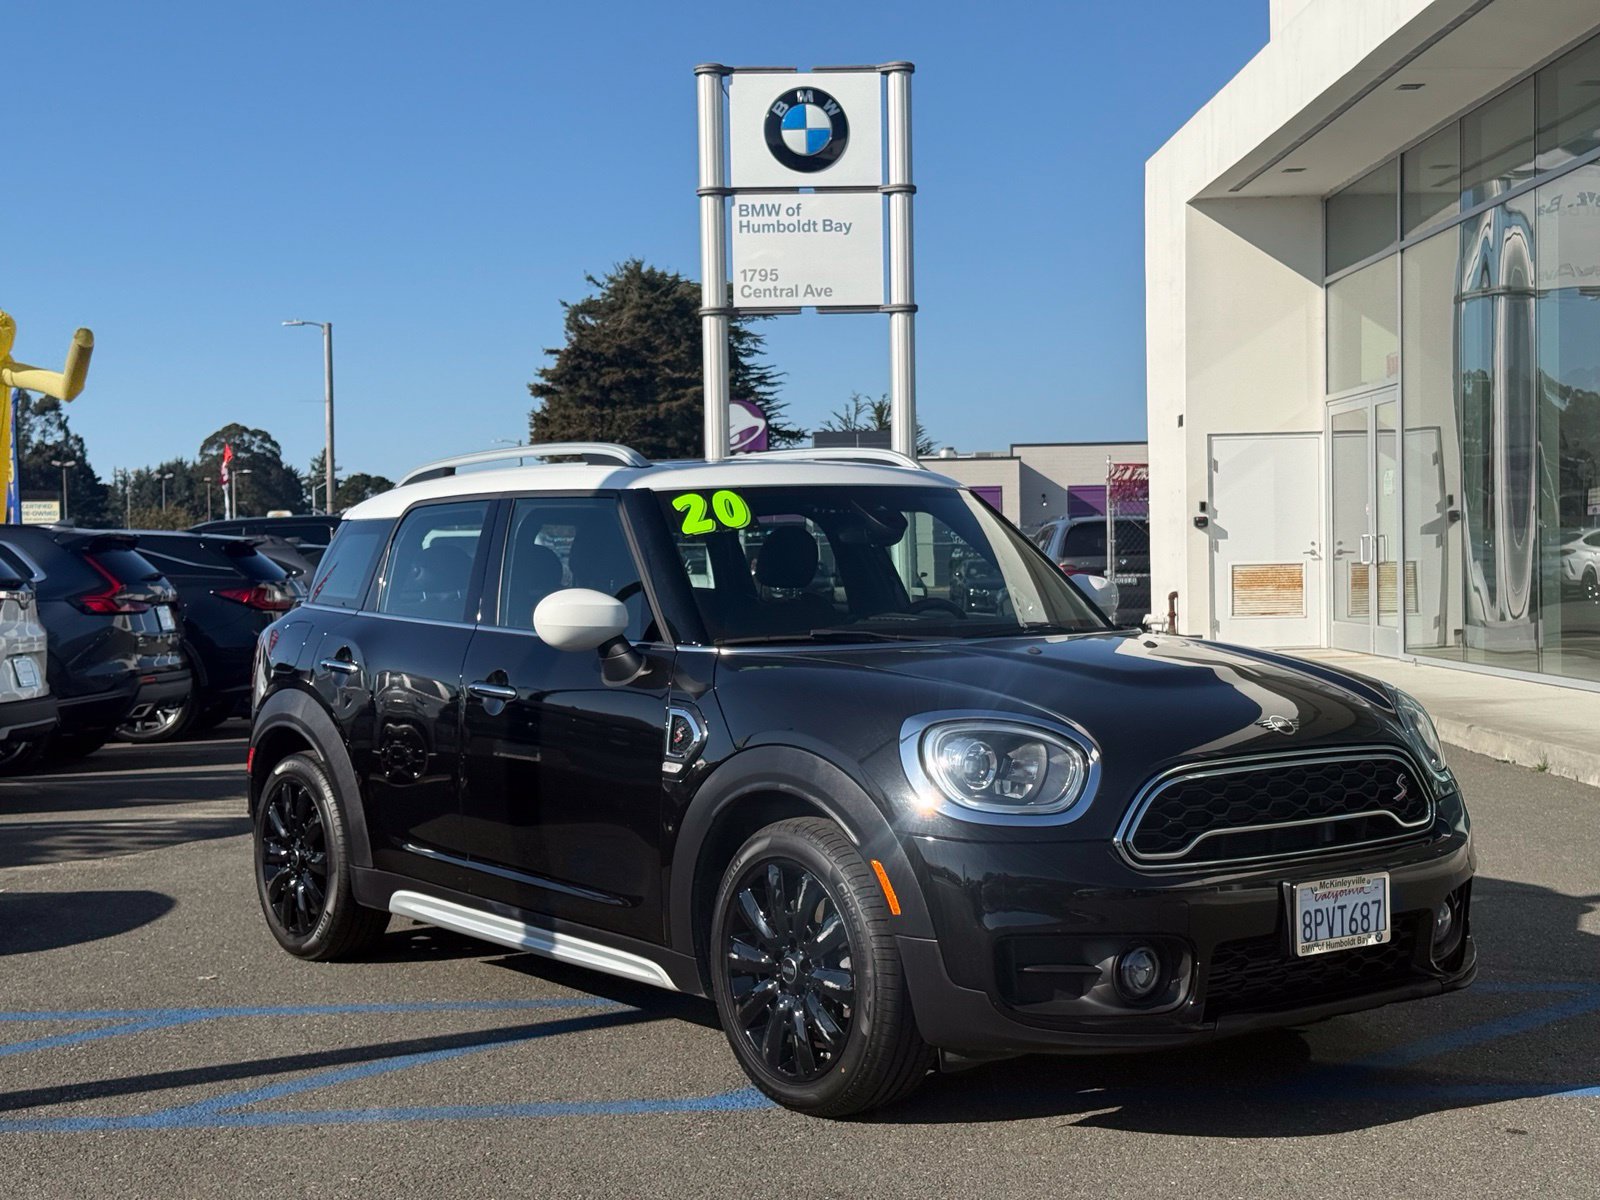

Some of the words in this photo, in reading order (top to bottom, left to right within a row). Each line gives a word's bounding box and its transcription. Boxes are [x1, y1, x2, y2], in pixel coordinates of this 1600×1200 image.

[772, 90, 840, 117] BMW
[738, 203, 782, 217] BMW
[785, 203, 802, 217] of
[738, 219, 818, 233] Humboldt
[822, 219, 853, 235] Bay
[740, 268, 779, 282] 1795
[740, 284, 799, 298] Central
[803, 284, 833, 298] Ave
[672, 490, 751, 535] 20
[1319, 876, 1366, 890] McKinleyville
[1302, 899, 1382, 942] 8PVT687
[1301, 943, 1315, 954] BMW
[1318, 942, 1325, 951] of
[1325, 938, 1356, 950] Humboldt
[1357, 936, 1369, 946] Bay
